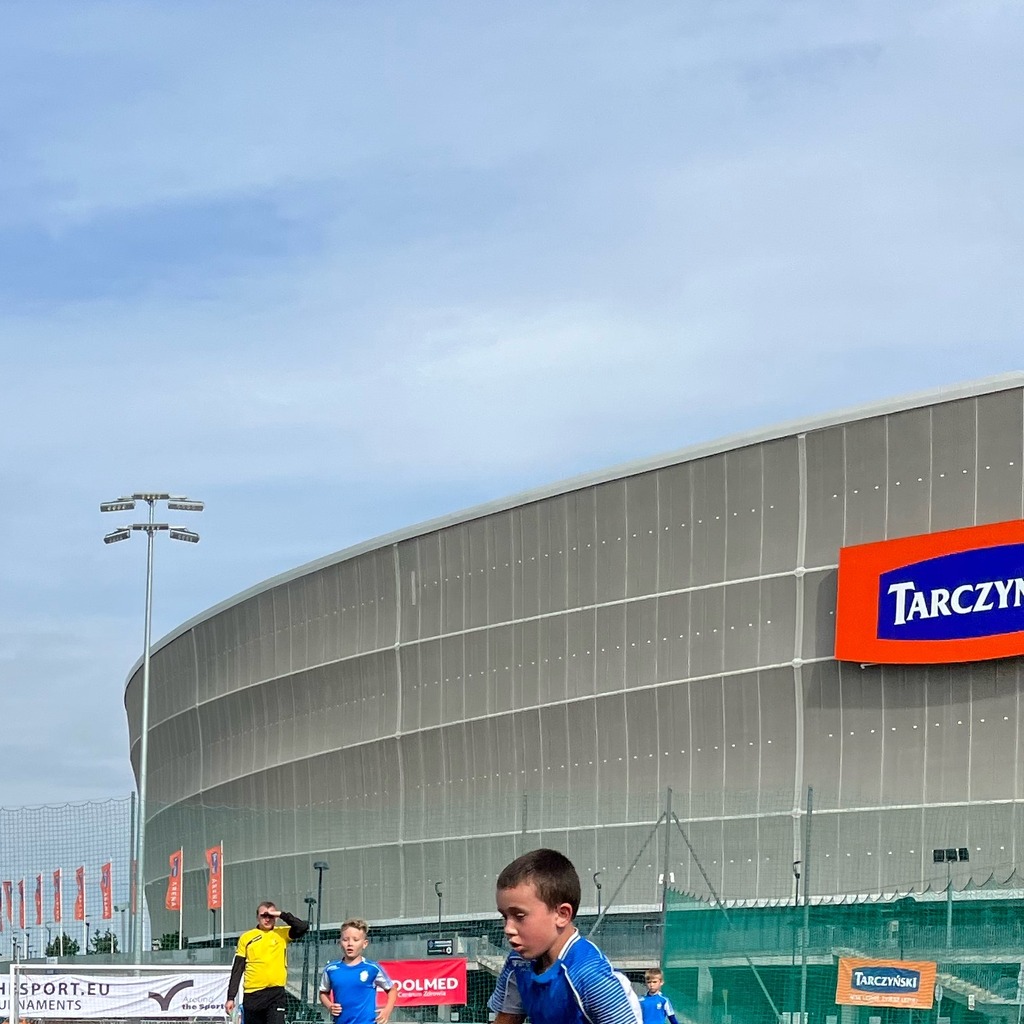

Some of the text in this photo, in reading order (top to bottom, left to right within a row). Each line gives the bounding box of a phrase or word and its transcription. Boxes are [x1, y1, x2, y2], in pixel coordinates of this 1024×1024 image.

[391, 977, 459, 991] DOLMED
[855, 971, 918, 988] TARCZYŃSKI
[198, 1003, 225, 1011] Sport
